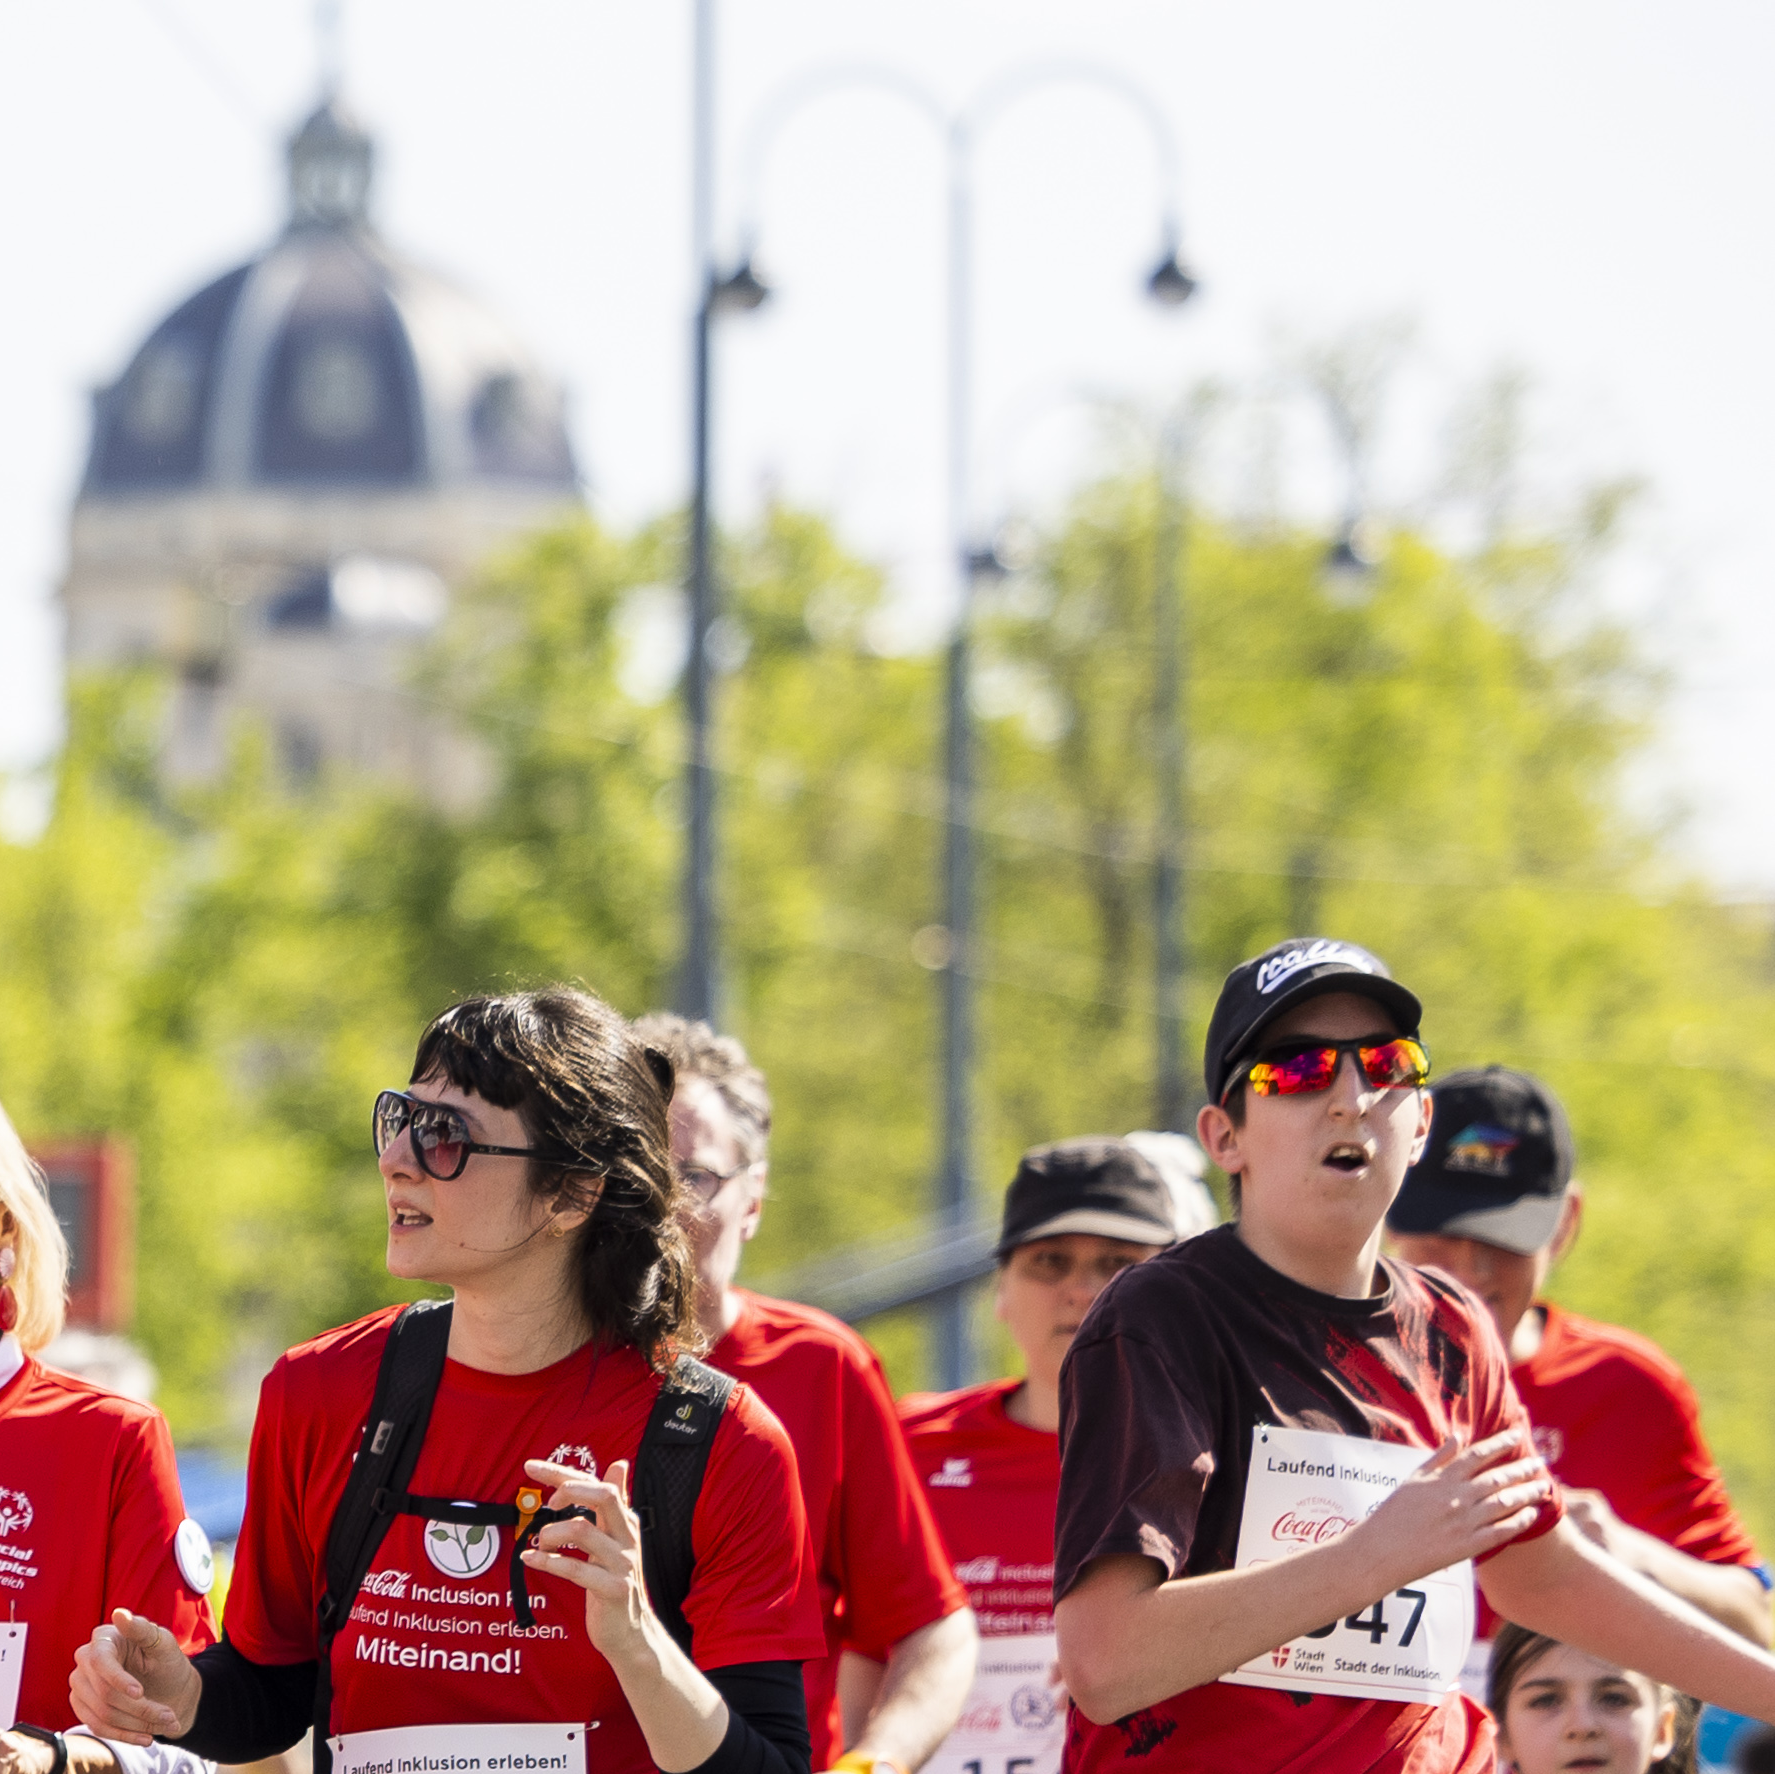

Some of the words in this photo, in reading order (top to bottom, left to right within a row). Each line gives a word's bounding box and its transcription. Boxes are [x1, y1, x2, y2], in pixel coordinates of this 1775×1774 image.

[1267, 1456, 1335, 1478] Laufend
[1339, 1464, 1397, 1487] Inklusion
[1295, 1496, 1345, 1514] MITEINAND
[410, 1582, 500, 1608] Inclusion
[392, 1612, 483, 1636] Inklusion
[1304, 1588, 1427, 1648] 47
[356, 1634, 522, 1675] Miteinand!
[1293, 1660, 1324, 1673] Wien
[1294, 1647, 1325, 1662] Stadt
[1334, 1657, 1366, 1673] Stadt
[1369, 1660, 1390, 1675] der
[1394, 1662, 1443, 1681] Inklusion.
[398, 1754, 480, 1773] Inklusion
[487, 1754, 568, 1770] erleben!
